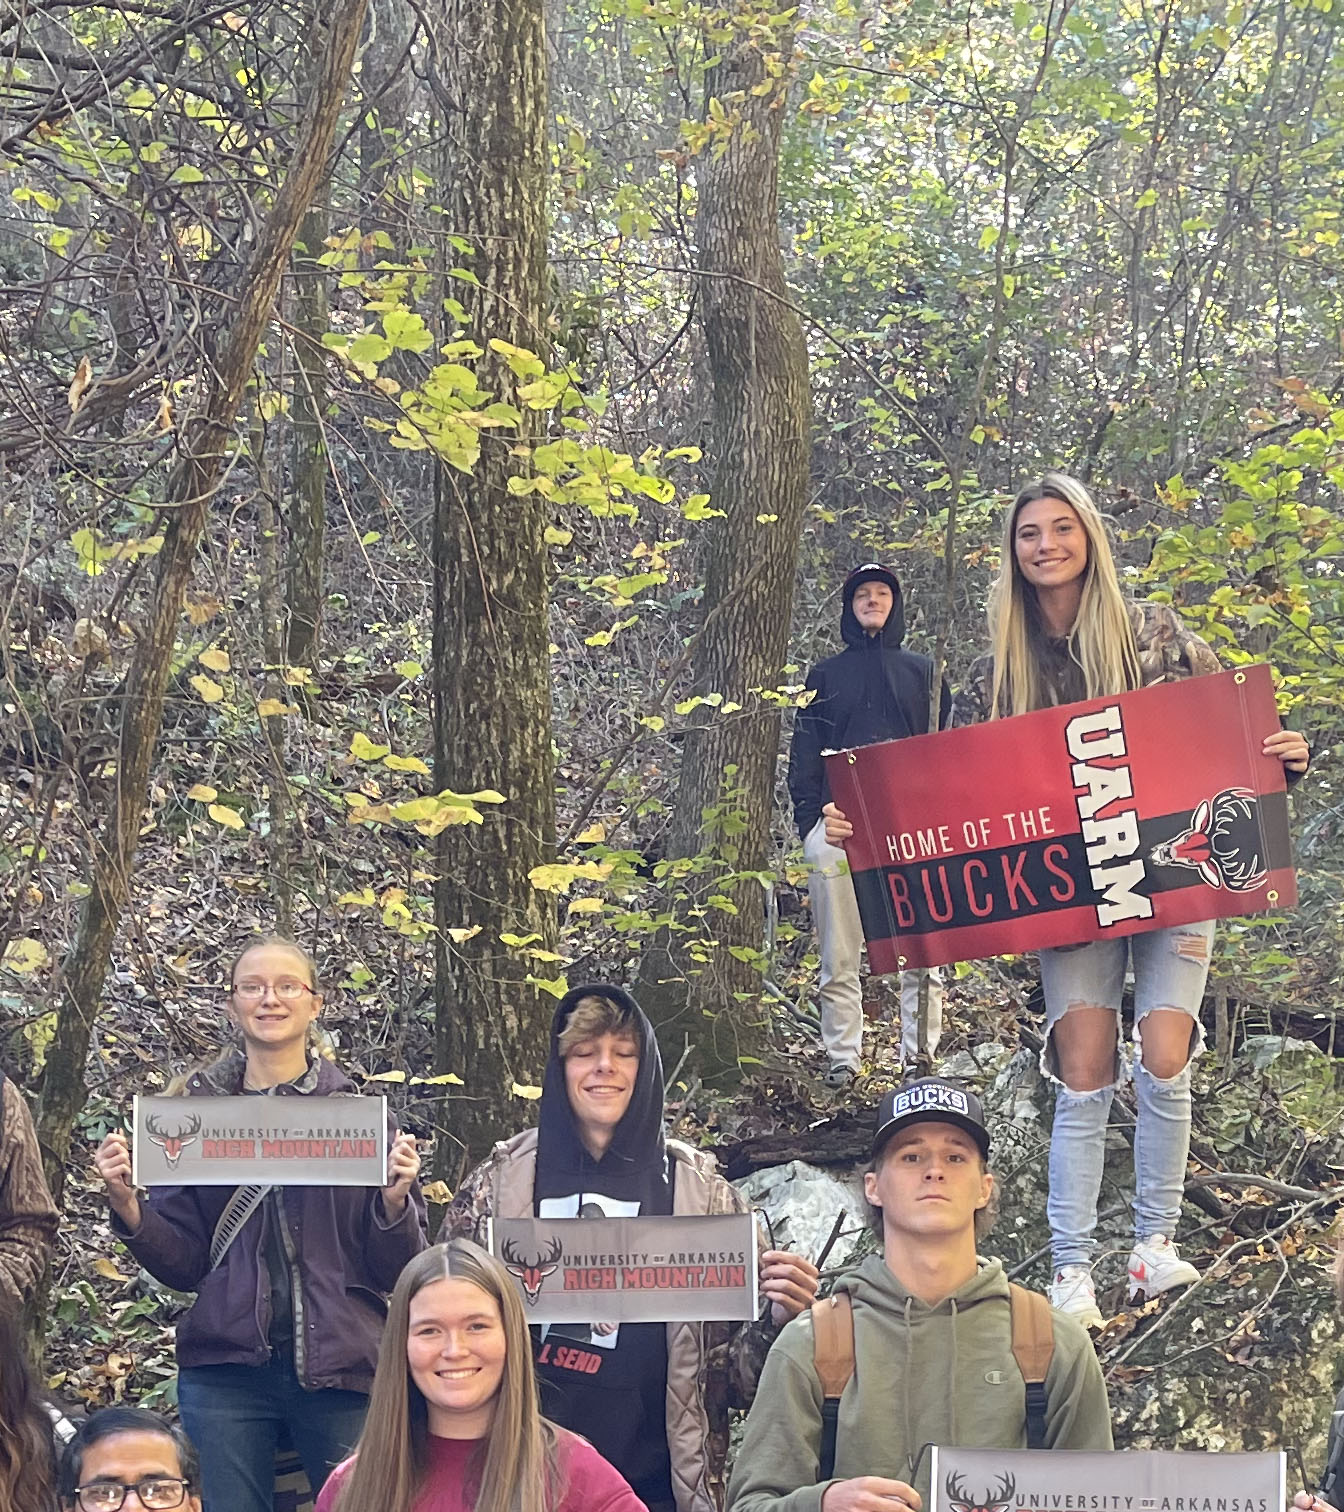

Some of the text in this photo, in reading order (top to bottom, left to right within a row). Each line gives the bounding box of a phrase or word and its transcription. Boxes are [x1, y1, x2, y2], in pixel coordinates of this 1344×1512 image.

[1064, 703, 1154, 928] UARM
[886, 806, 1055, 862] HOME OF THE
[887, 844, 1076, 928] BUCKS
[897, 1088, 964, 1111] BUCKS
[201, 1127, 290, 1139] UNIVERSITY
[307, 1127, 377, 1139] ARKANSAS
[202, 1139, 377, 1159] RICH MOUNTAIN
[563, 1253, 649, 1266] UNIVERSITY
[668, 1251, 745, 1265] ARKANSAS
[563, 1265, 746, 1290] RICH MOUNTAIN
[552, 1346, 603, 1375] SEND
[1014, 1494, 1134, 1509] UNIVERSITY
[1161, 1497, 1268, 1512] ARKANSAS
